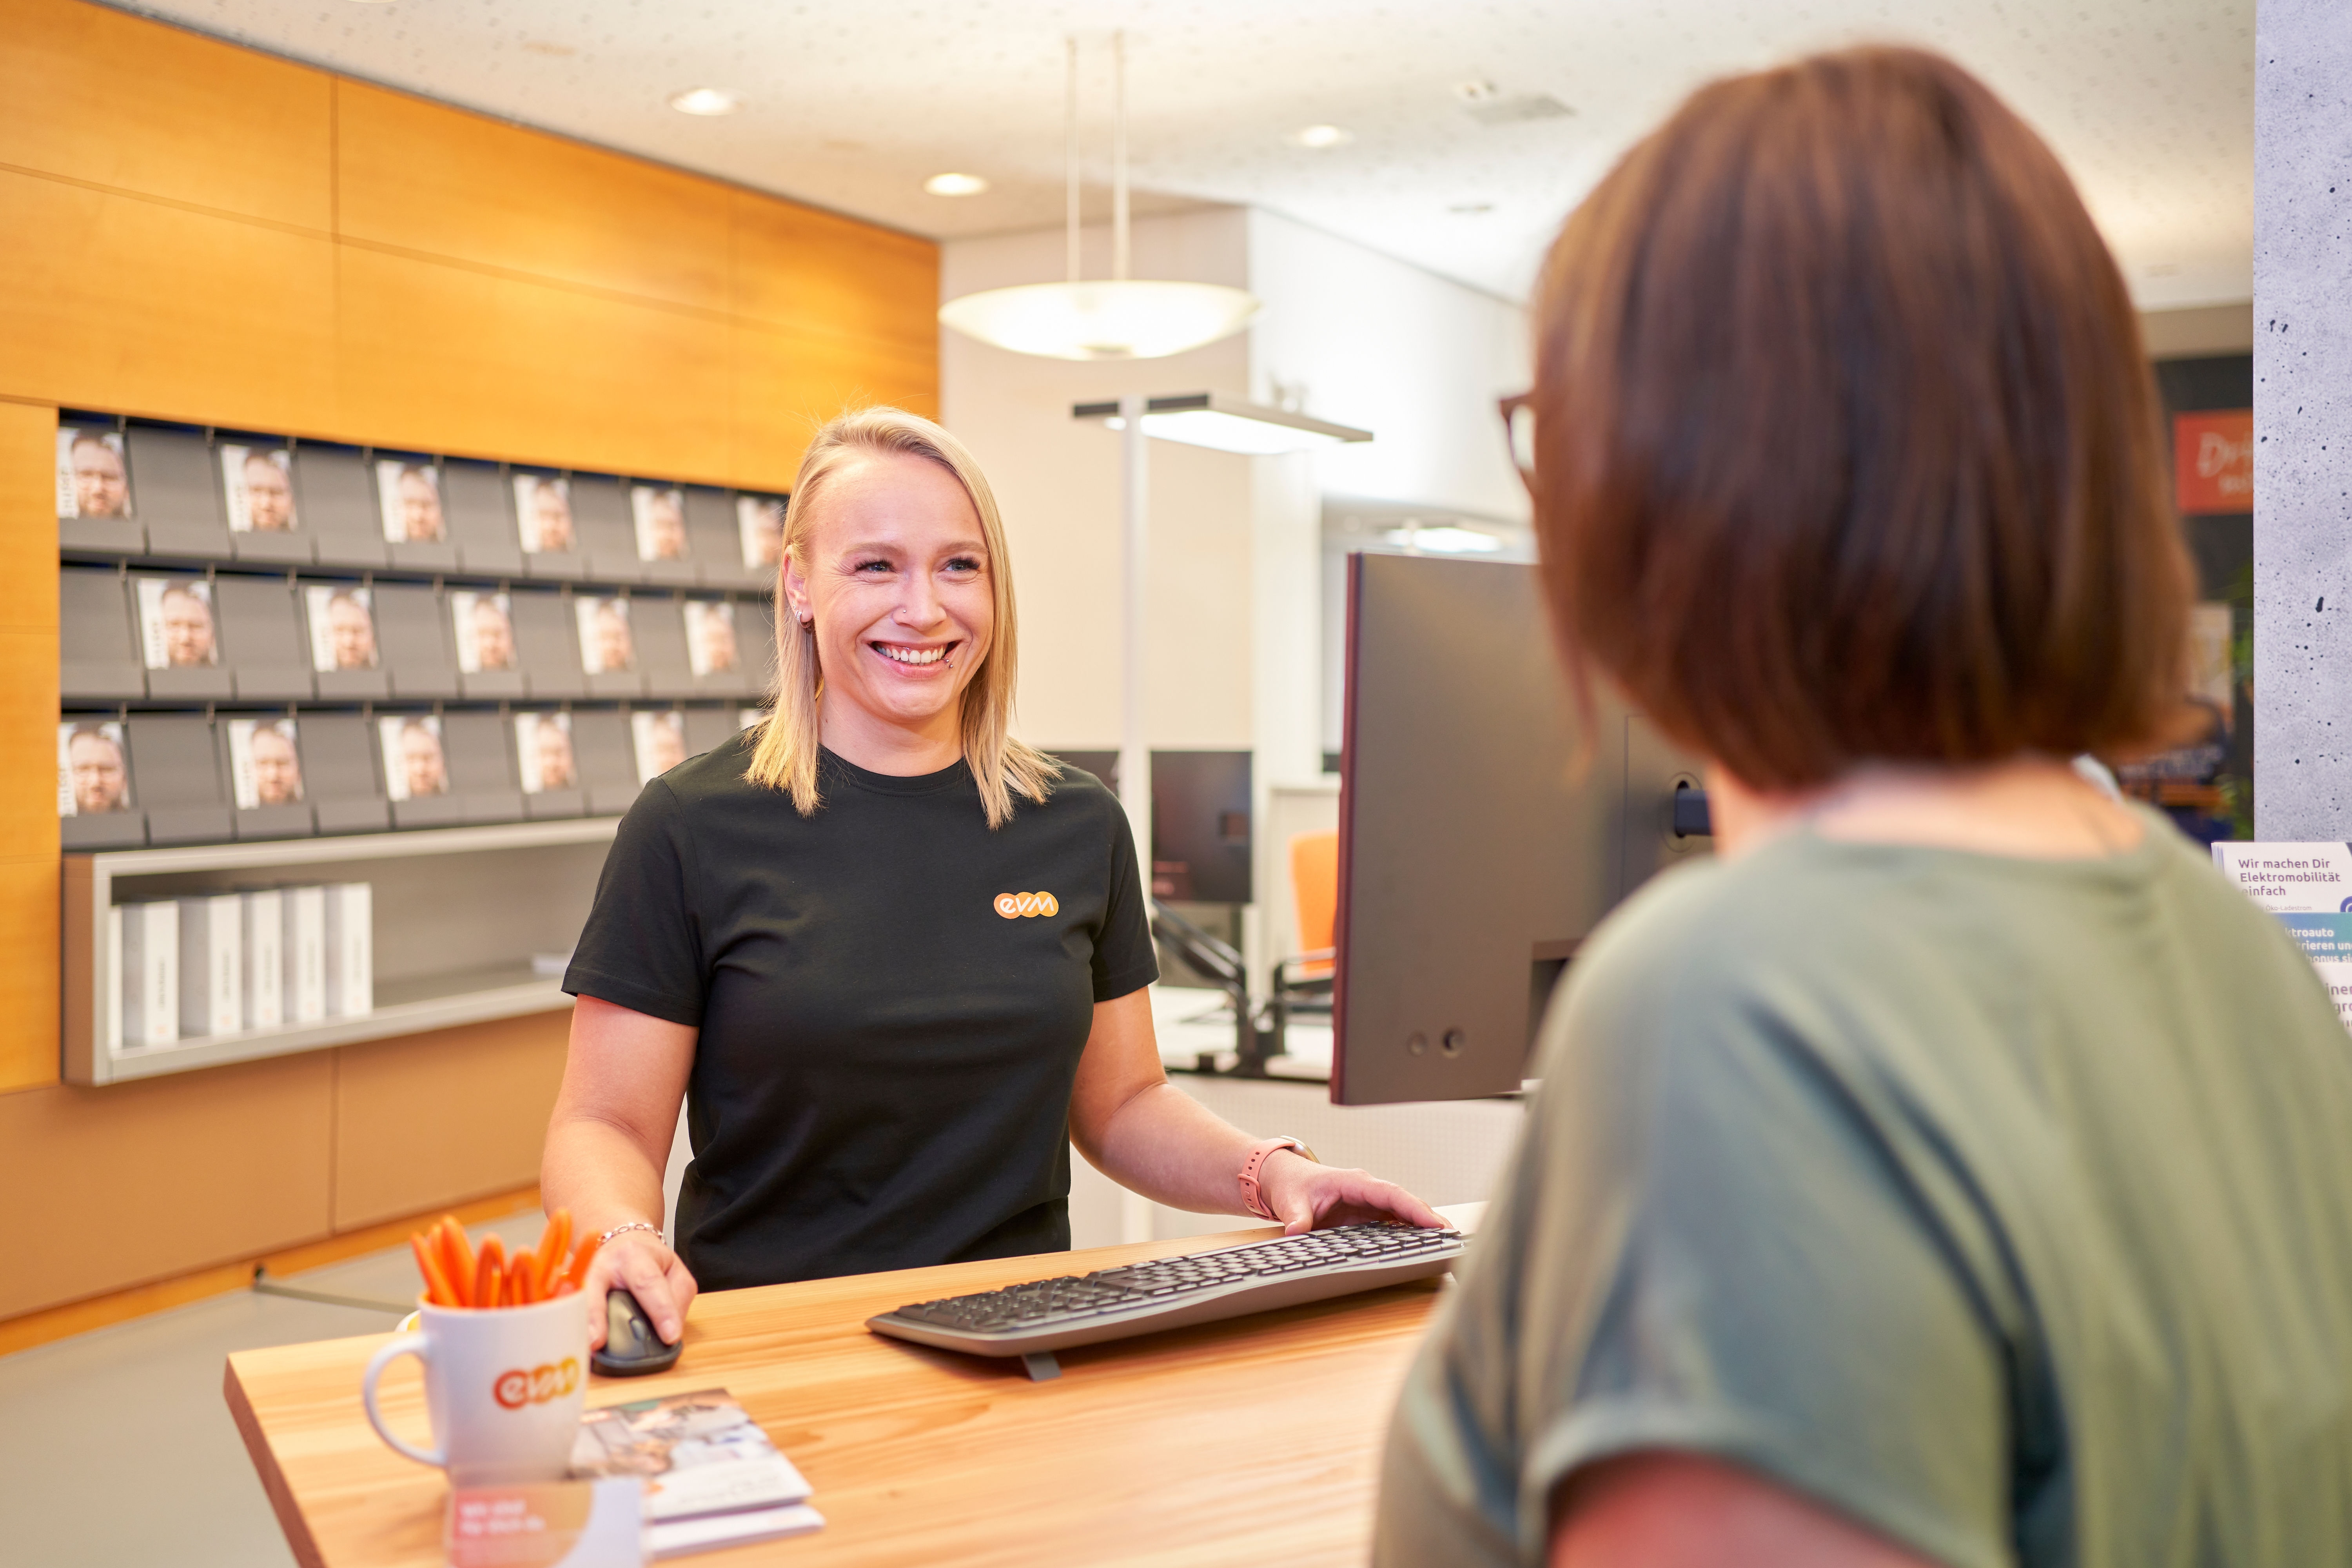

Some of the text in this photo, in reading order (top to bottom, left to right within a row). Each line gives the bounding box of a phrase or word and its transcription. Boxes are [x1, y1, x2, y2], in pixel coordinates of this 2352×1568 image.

[2238, 858, 2330, 868] Wir machen Dir
[2240, 872, 2341, 882] Elektromobilität
[2241, 886, 2286, 896] einfach
[999, 896, 1054, 914] evm
[2285, 927, 2335, 937] ktroauto
